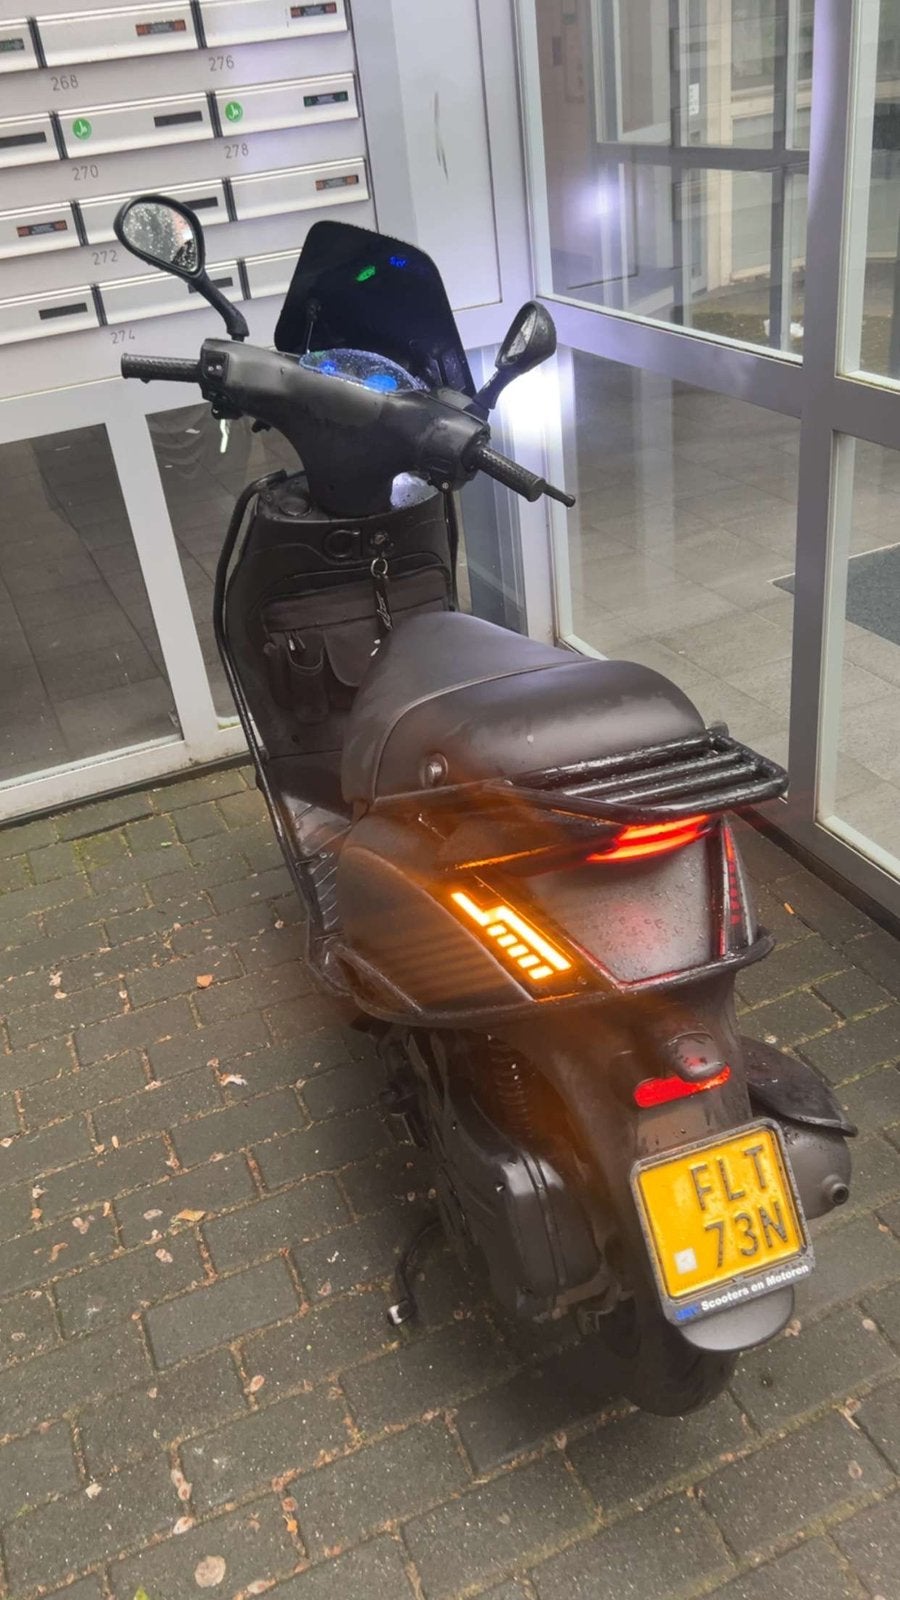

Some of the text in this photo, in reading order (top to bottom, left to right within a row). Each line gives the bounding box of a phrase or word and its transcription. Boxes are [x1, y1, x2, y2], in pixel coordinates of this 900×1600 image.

[208, 55, 235, 72] 276
[50, 74, 79, 91] 268
[224, 142, 249, 159] 278
[72, 164, 99, 181] 270
[92, 249, 118, 266] 272
[689, 1144, 767, 1211] FLT
[704, 1200, 788, 1268] 73N
[701, 1264, 809, 1311] Scooters en Motoren
